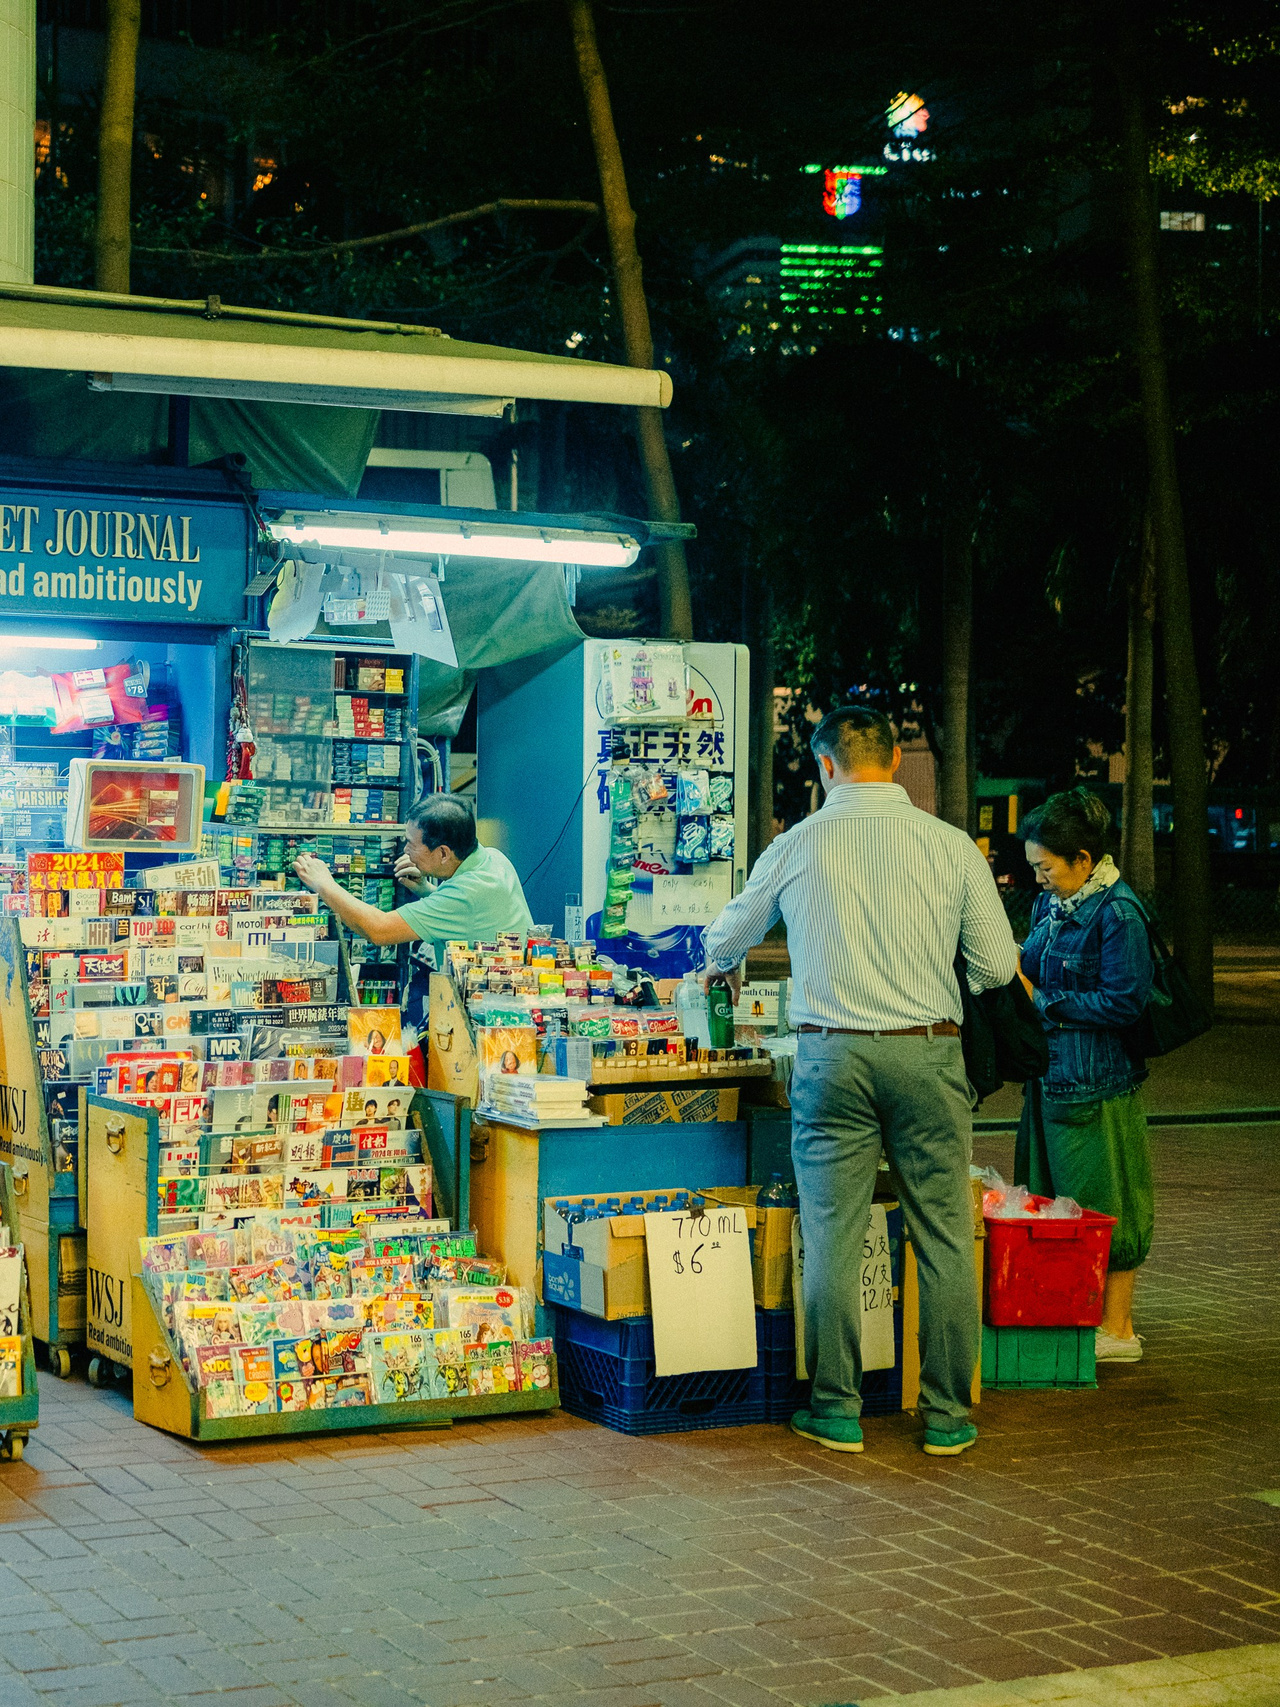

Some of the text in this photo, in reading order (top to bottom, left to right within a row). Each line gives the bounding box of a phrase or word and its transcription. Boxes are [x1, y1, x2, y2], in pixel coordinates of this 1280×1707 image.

[45, 507, 201, 563] JOURNAL
[34, 564, 203, 612] ambitiously
[128, 685, 144, 694] $78
[52, 853, 99, 871] 2024
[220, 890, 249, 907] Travel
[133, 922, 153, 937] TOP
[213, 966, 279, 984] Wine Spectator
[210, 1039, 241, 1056] MR
[0, 1085, 28, 1135] WSJ
[0, 1136, 11, 1155] Read
[672, 1215, 711, 1239] 770
[88, 1266, 125, 1328] WSJ
[88, 1321, 133, 1359] Read ambitio
